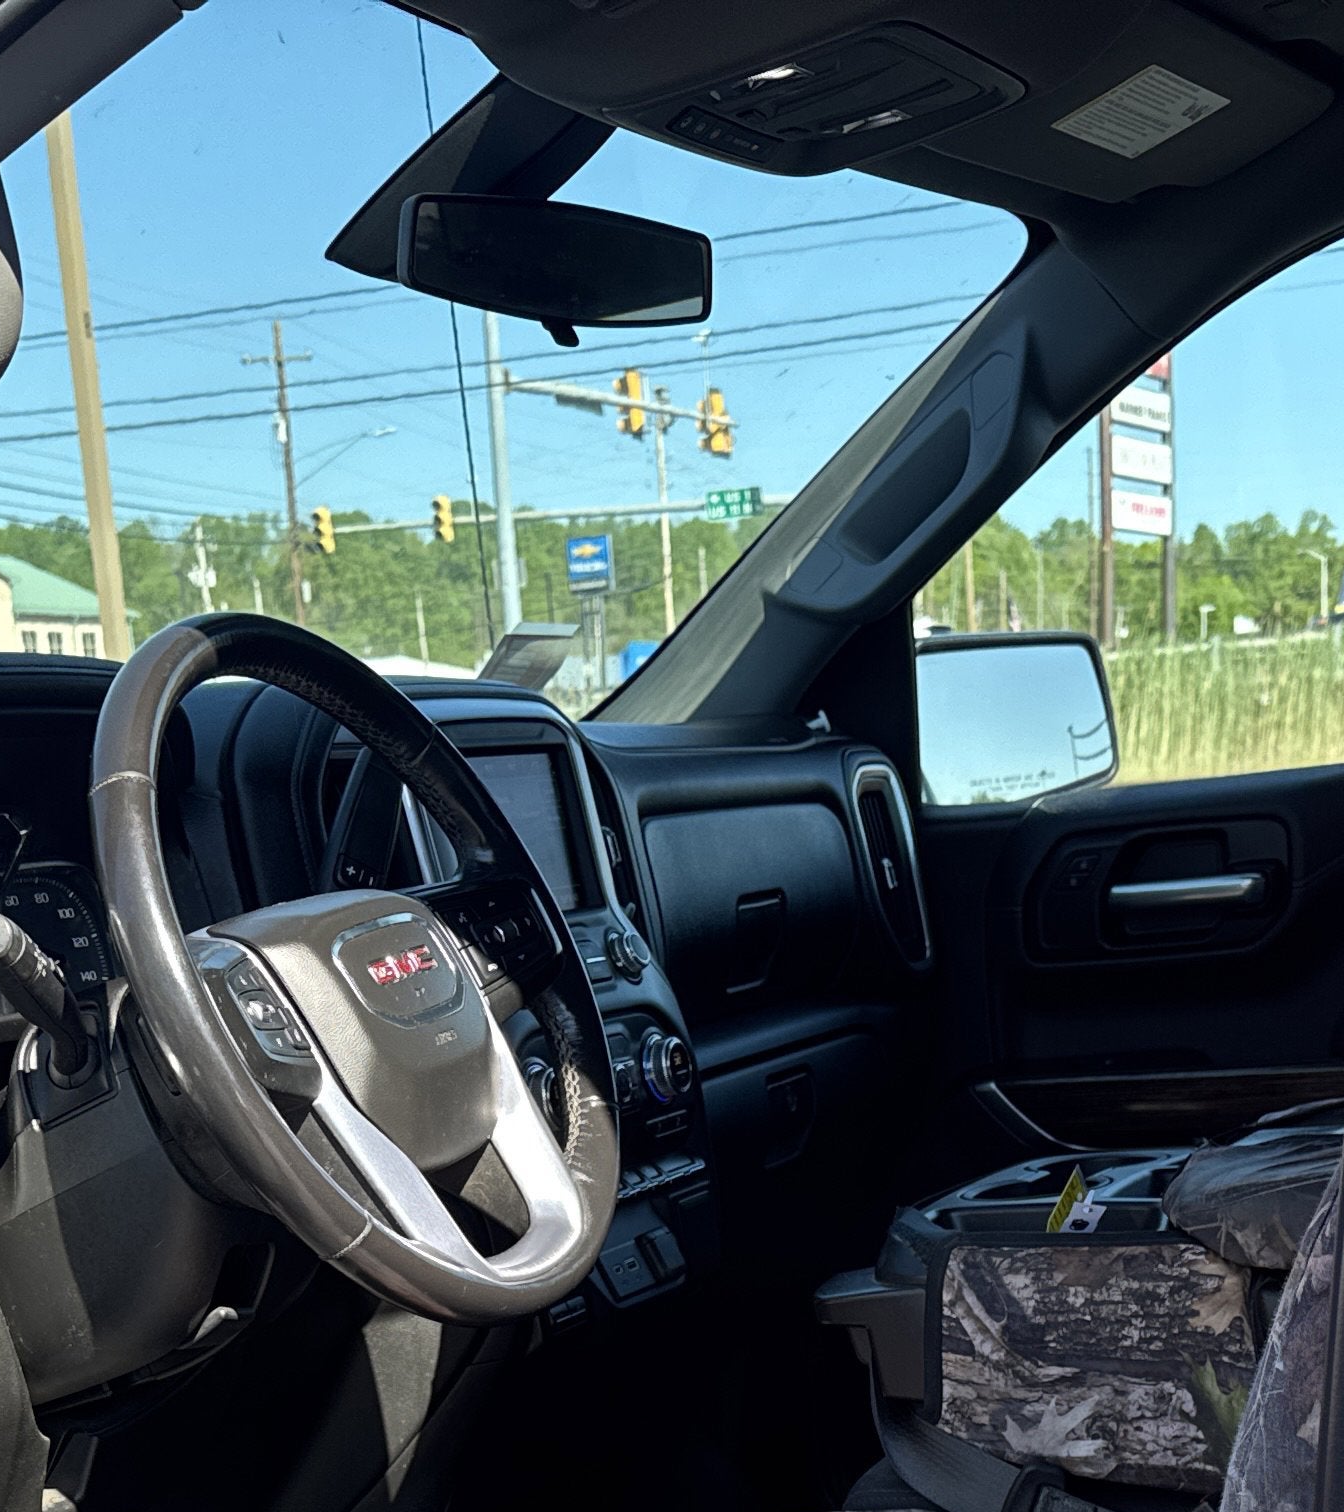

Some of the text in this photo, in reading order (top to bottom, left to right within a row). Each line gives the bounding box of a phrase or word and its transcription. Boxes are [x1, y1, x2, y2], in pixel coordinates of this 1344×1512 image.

[57, 908, 75, 919] 100
[72, 936, 89, 948] 120
[366, 944, 438, 985] GMC
[80, 970, 97, 982] 140
